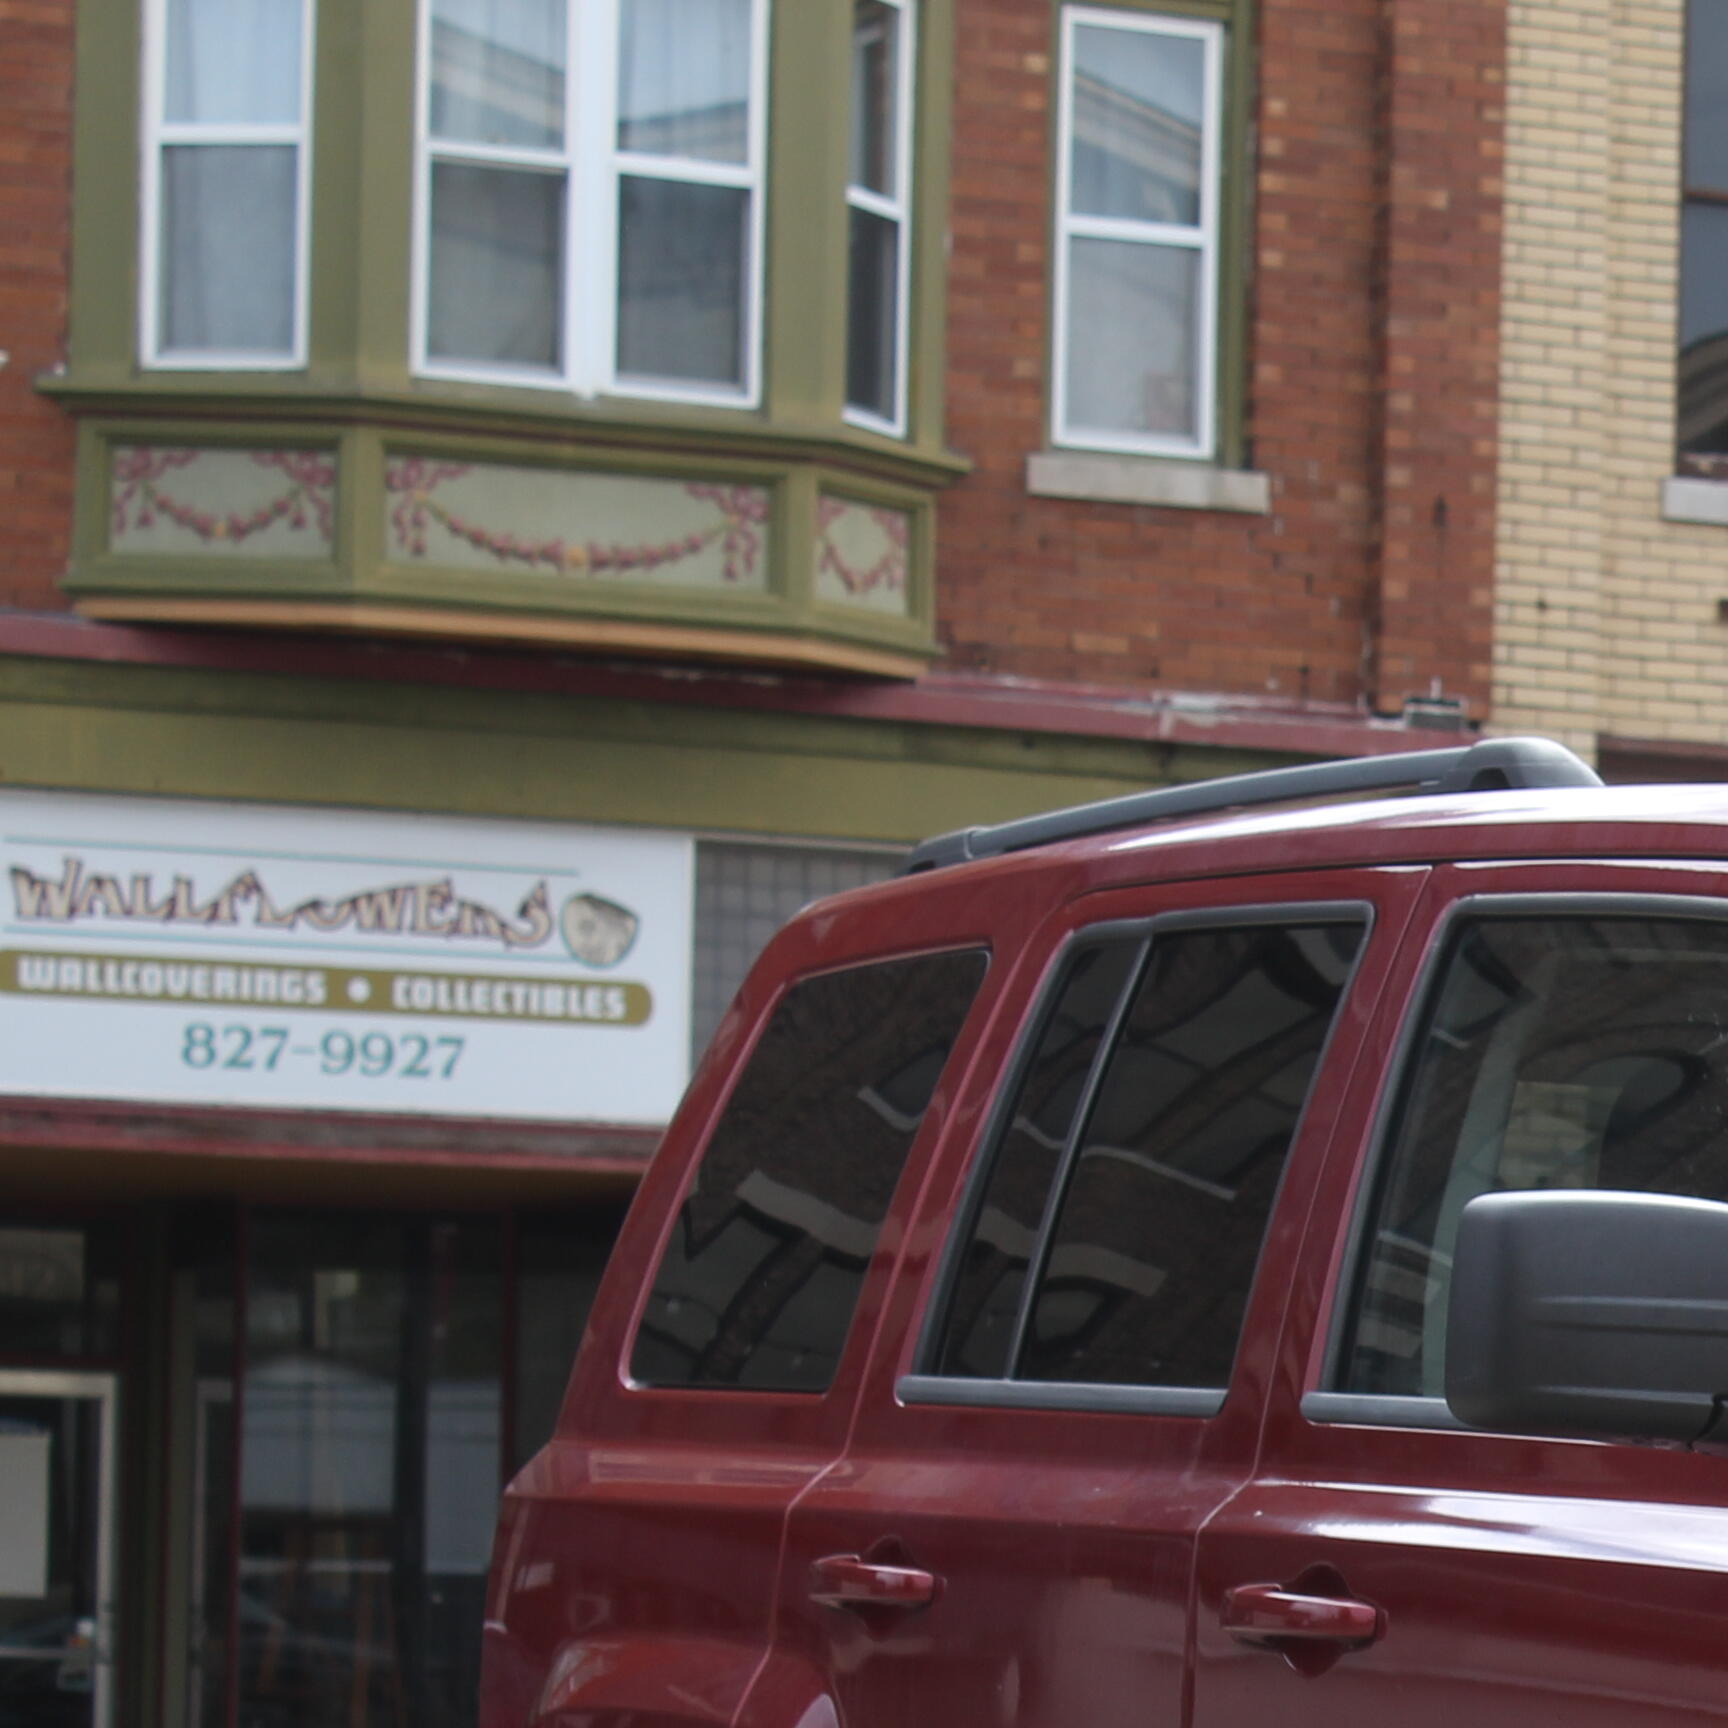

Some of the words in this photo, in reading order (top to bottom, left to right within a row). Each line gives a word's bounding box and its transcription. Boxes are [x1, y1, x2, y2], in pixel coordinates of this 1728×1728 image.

[17, 955, 328, 1005] WALLCOVERINGS
[392, 973, 627, 1021] COLLECTIBLES
[181, 1021, 465, 1079] 827-9927
